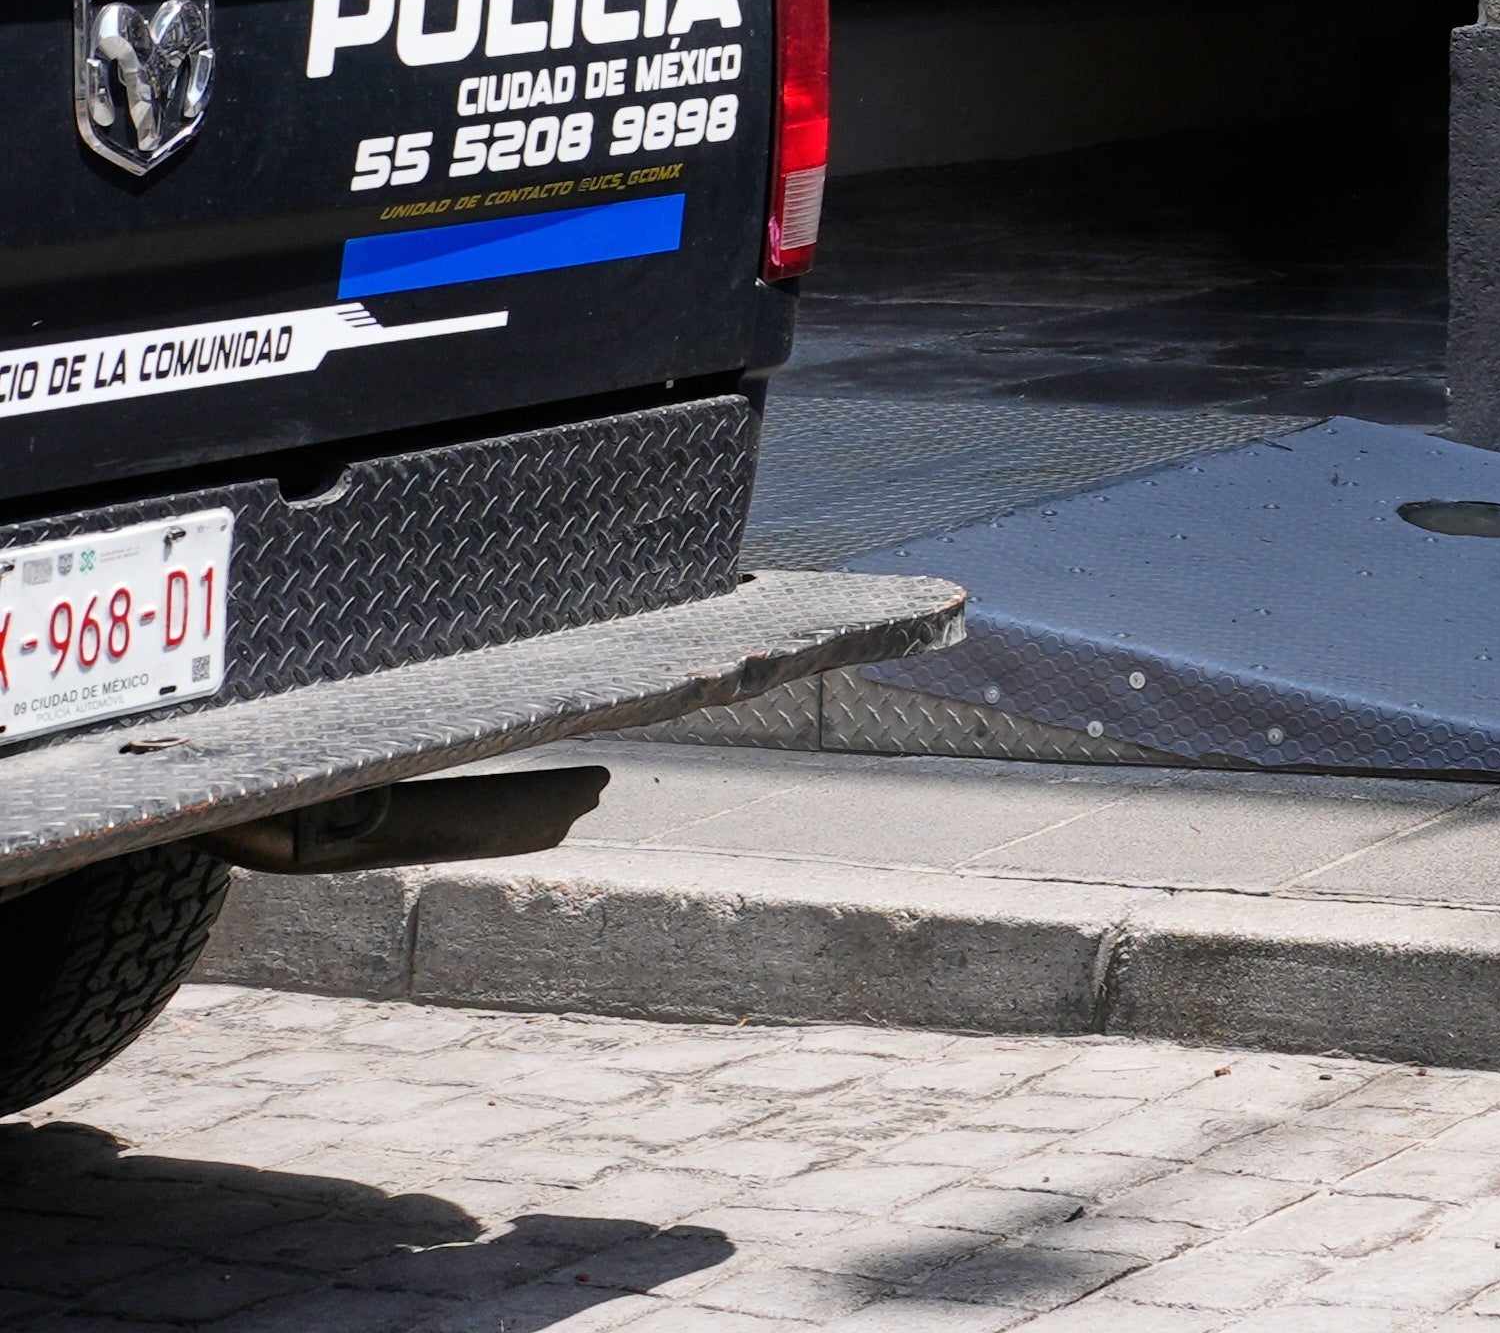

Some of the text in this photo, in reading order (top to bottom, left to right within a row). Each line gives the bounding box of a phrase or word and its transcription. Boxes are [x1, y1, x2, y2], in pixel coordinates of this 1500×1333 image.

[456, 37, 743, 117] CIUDAD DE MÉXICO
[350, 93, 739, 192] 55 5208 9898
[379, 197, 452, 221] UNIDAD
[454, 194, 482, 210] DE
[483, 180, 575, 207] CONTACTO
[47, 354, 87, 396] DE
[93, 348, 127, 390] LA
[139, 325, 294, 383] COMUNIDAD
[13, 671, 150, 717] 09 CIUDAD DE MÉXICO
[36, 705, 72, 724] POLICÍA
